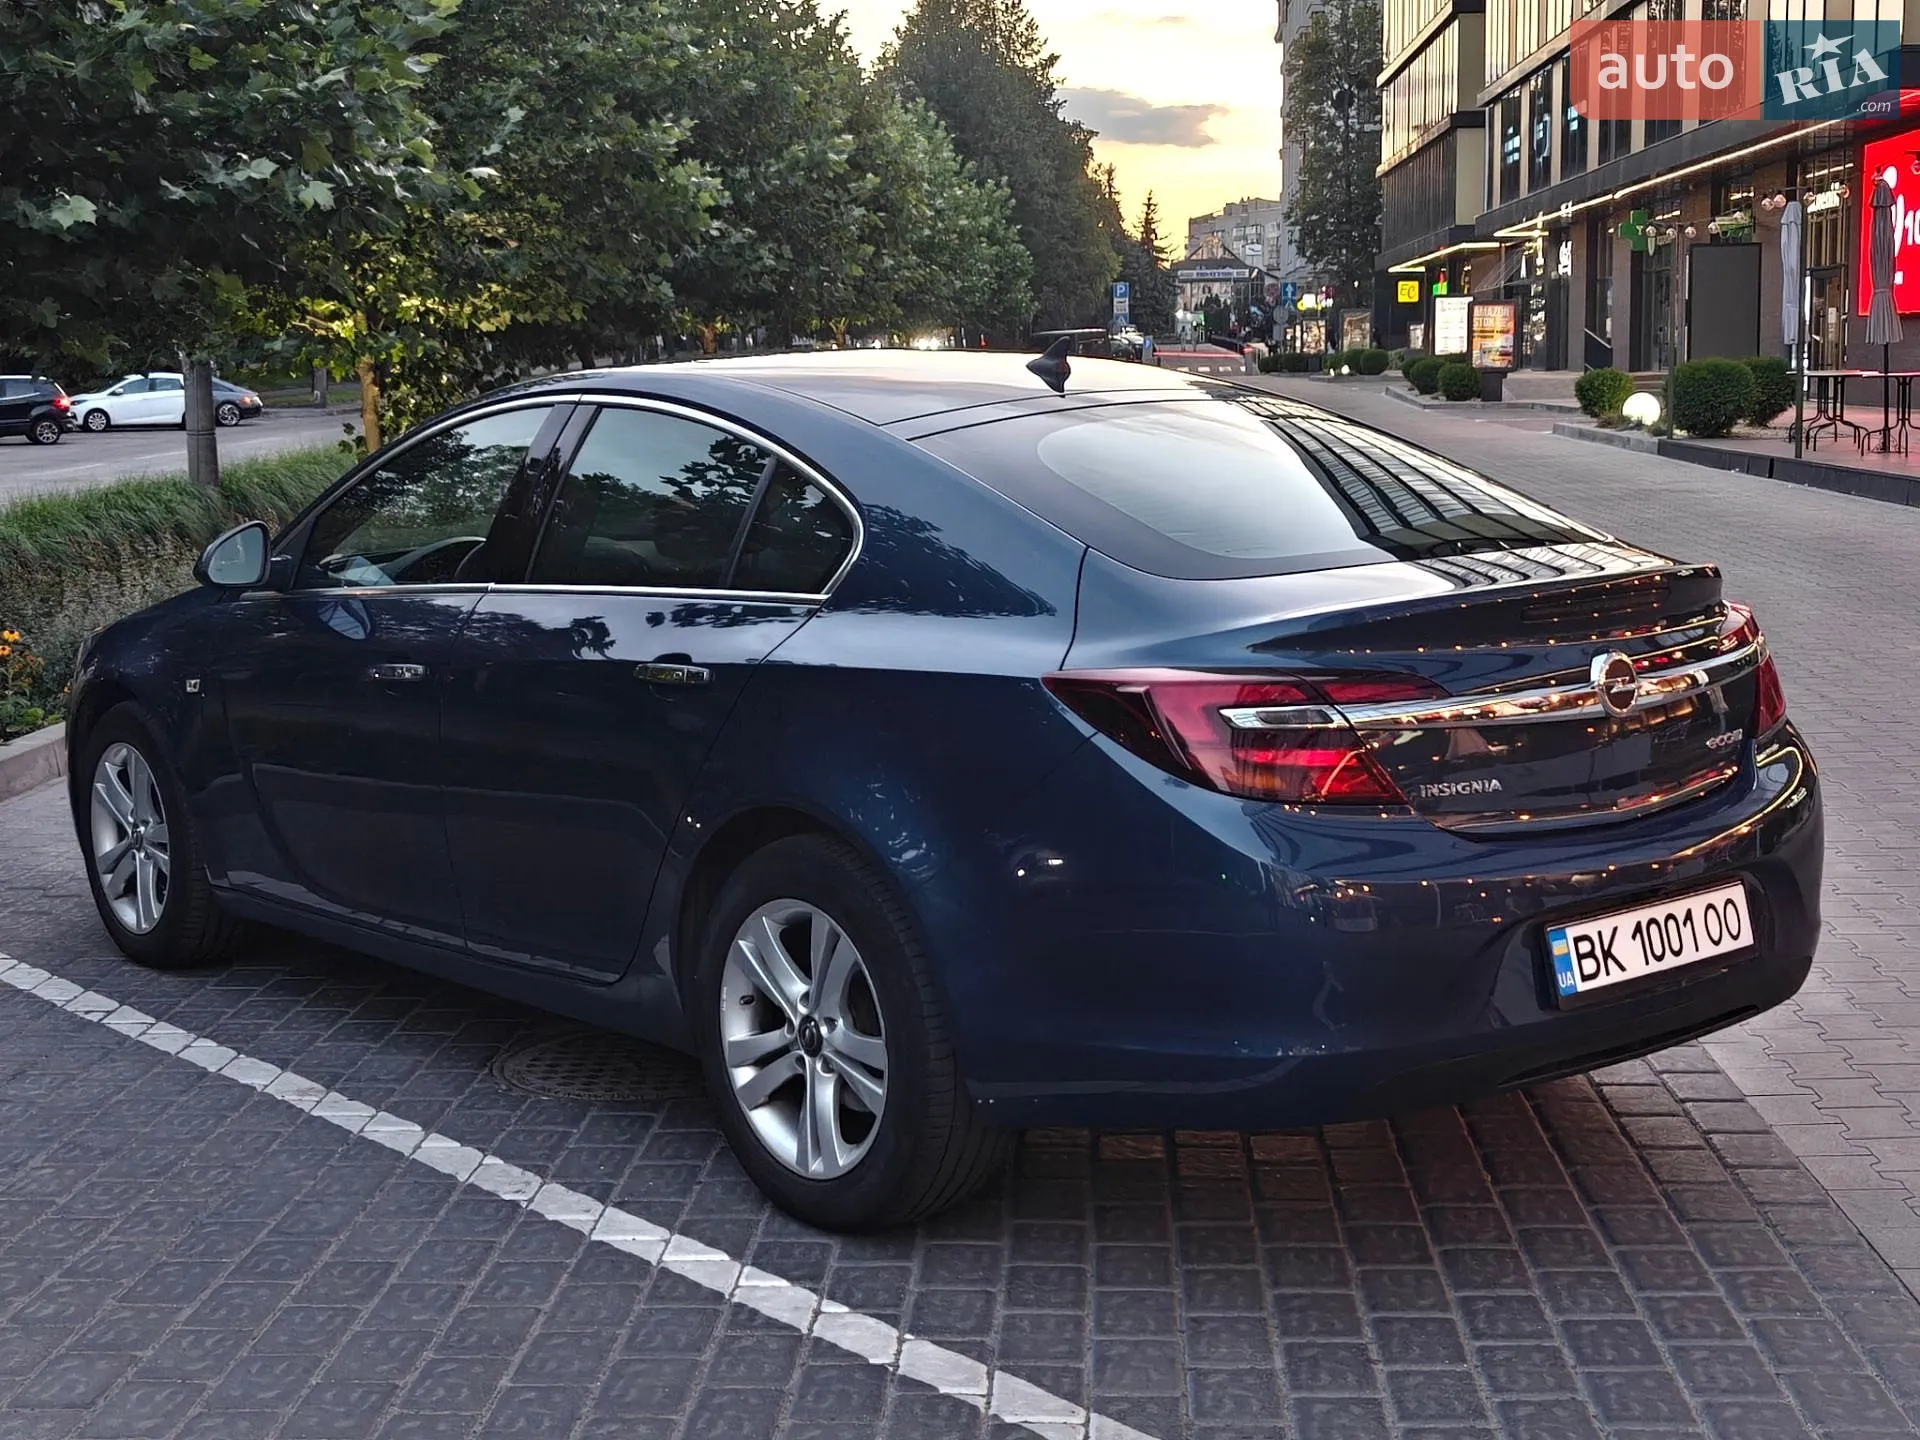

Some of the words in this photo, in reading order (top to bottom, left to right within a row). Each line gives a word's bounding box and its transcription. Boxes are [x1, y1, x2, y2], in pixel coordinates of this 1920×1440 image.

[1116, 284, 1126, 297] P
[1420, 778, 1503, 799] INSIGNIA
[1573, 926, 1627, 982] BK
[1631, 908, 1699, 966] 1001
[1558, 973, 1575, 988] UA
